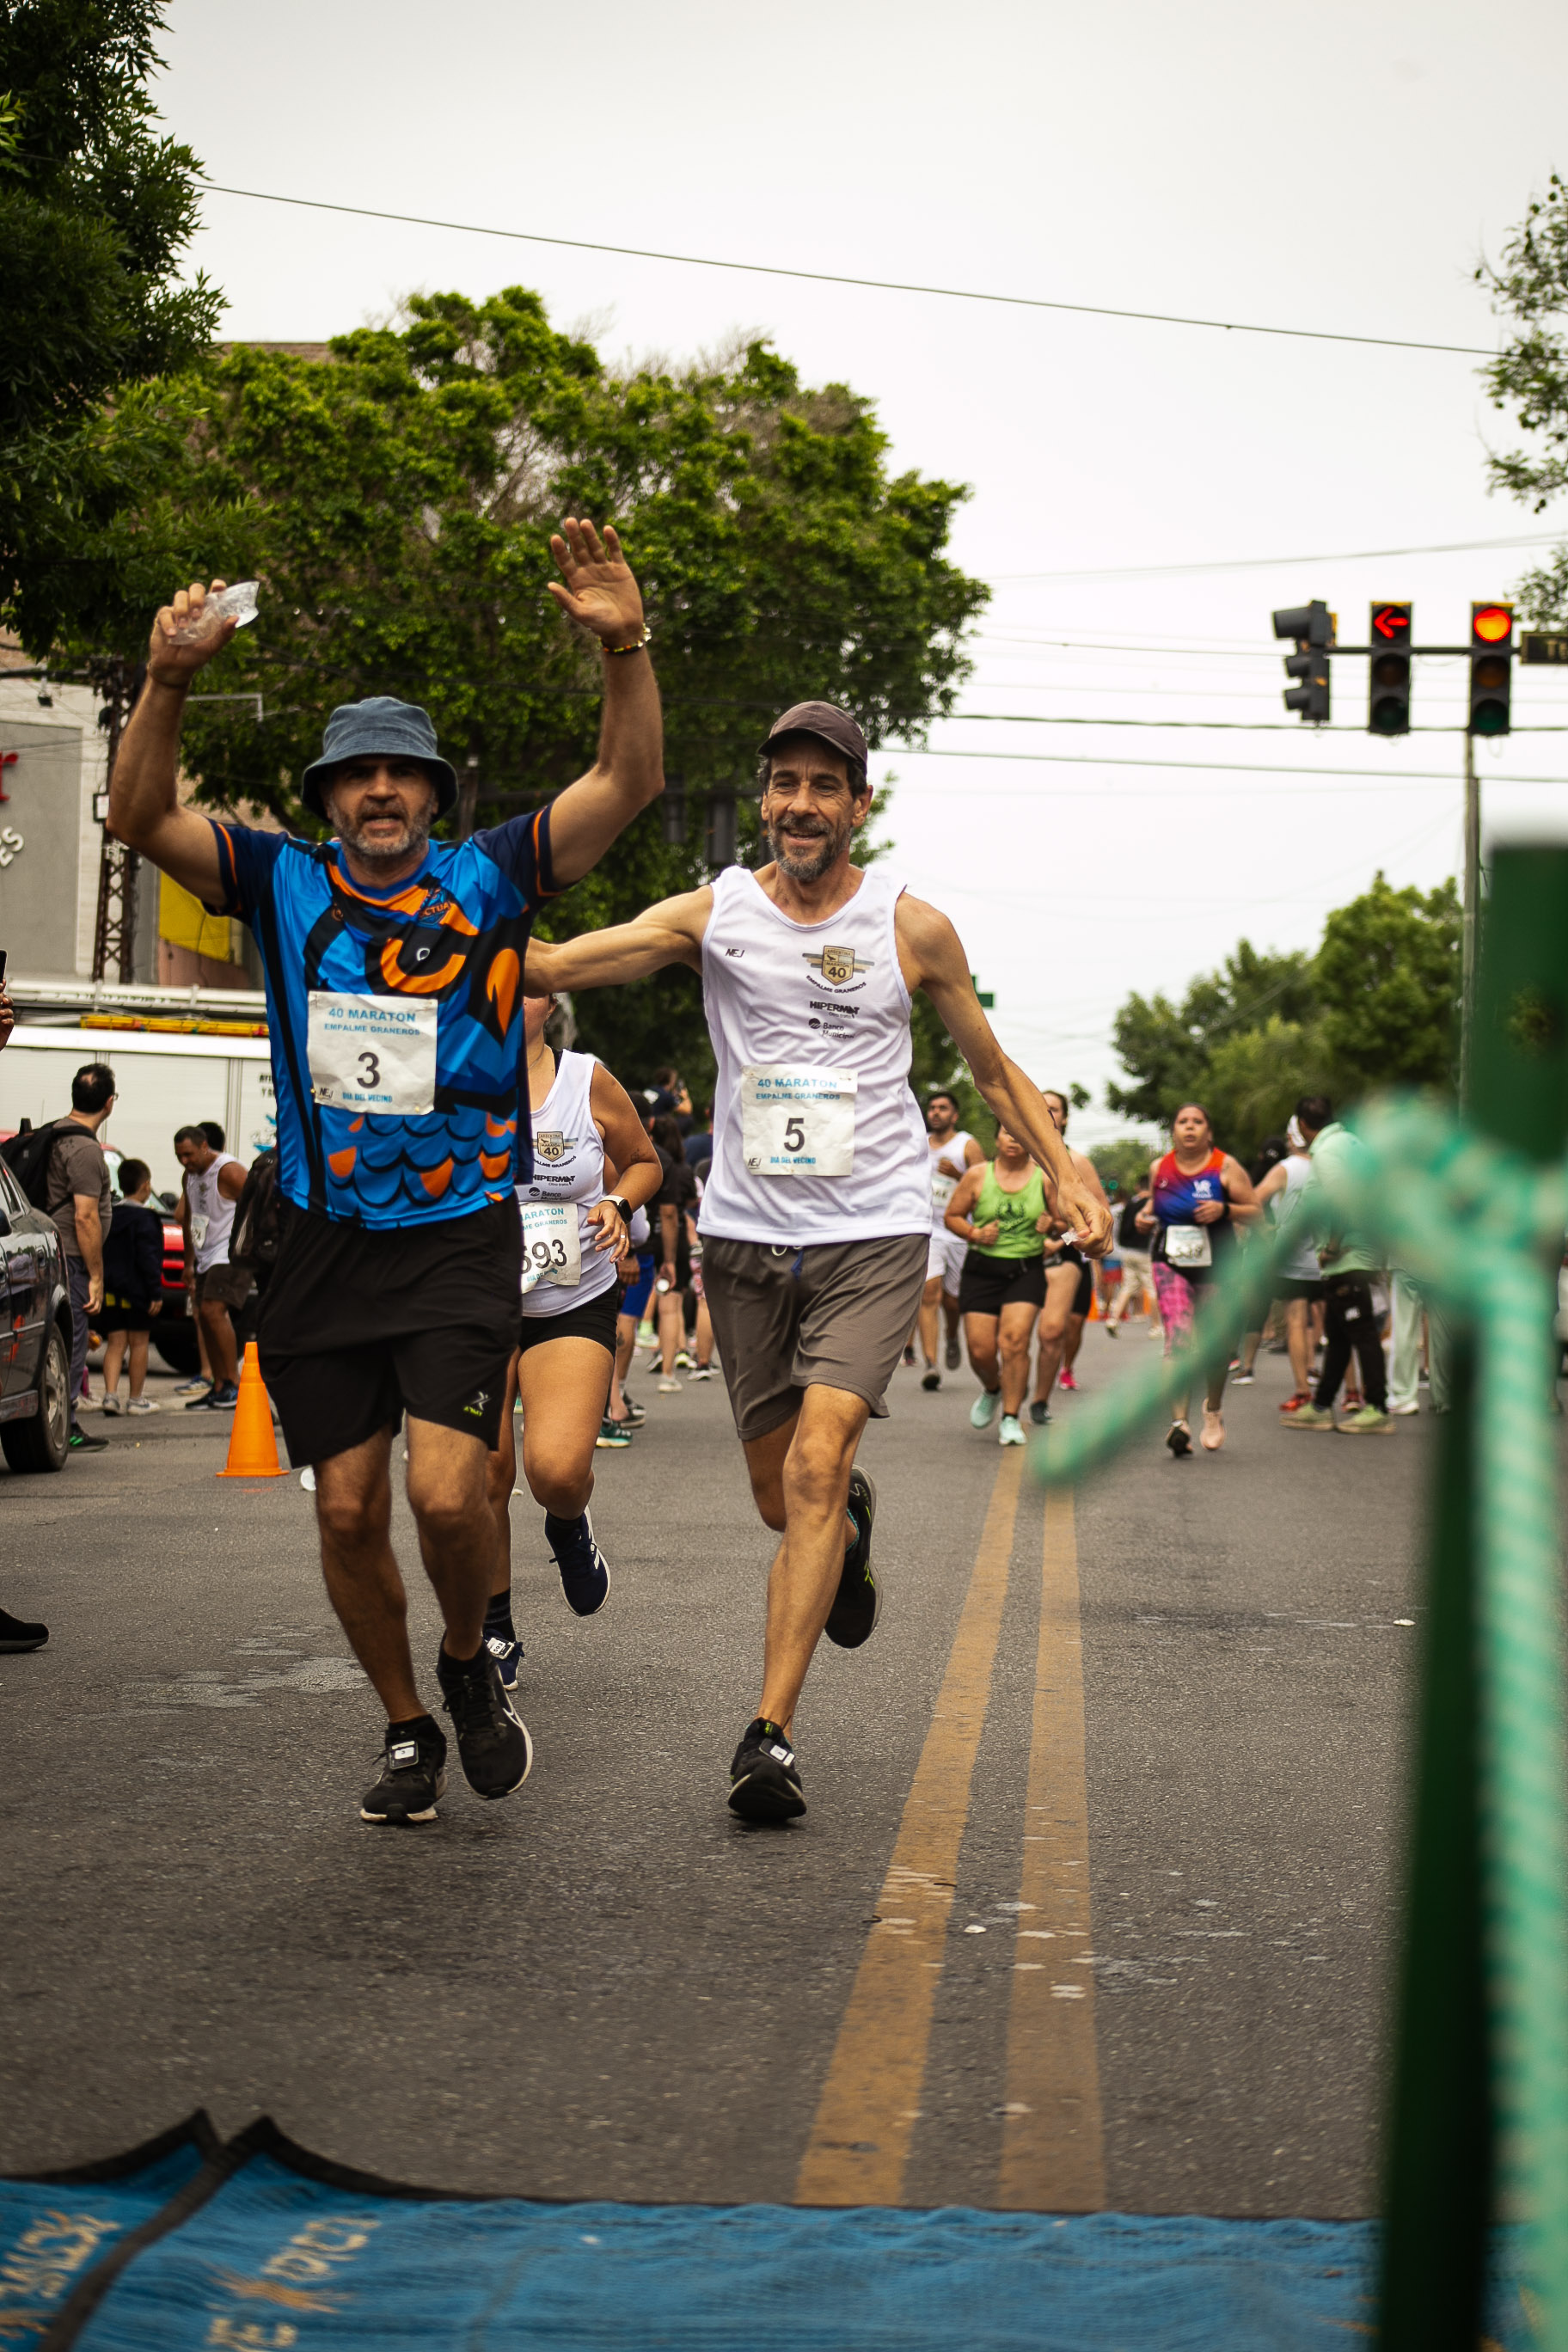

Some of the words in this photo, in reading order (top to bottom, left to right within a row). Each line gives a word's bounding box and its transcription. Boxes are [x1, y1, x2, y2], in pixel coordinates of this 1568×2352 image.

[726, 948, 745, 959] NEJ
[828, 966, 847, 978] 40
[806, 975, 833, 993] EMPALME
[834, 981, 867, 994] GRANEROS
[809, 1001, 860, 1016] HIPERMAT
[328, 1008, 344, 1019] 40
[348, 1009, 417, 1023] MARATON
[324, 1023, 368, 1032] EMPALME
[371, 1026, 421, 1036] GRANEROS
[823, 1022, 844, 1031] Banco
[357, 1051, 381, 1089] 3
[757, 1078, 771, 1087] 40
[775, 1078, 837, 1088] MARATON
[319, 1087, 334, 1099] NEJ
[783, 1118, 805, 1152] 5
[543, 1147, 560, 1156] 40
[551, 1155, 577, 1167] GRANEROS
[535, 1219, 567, 1228] GRANEROS
